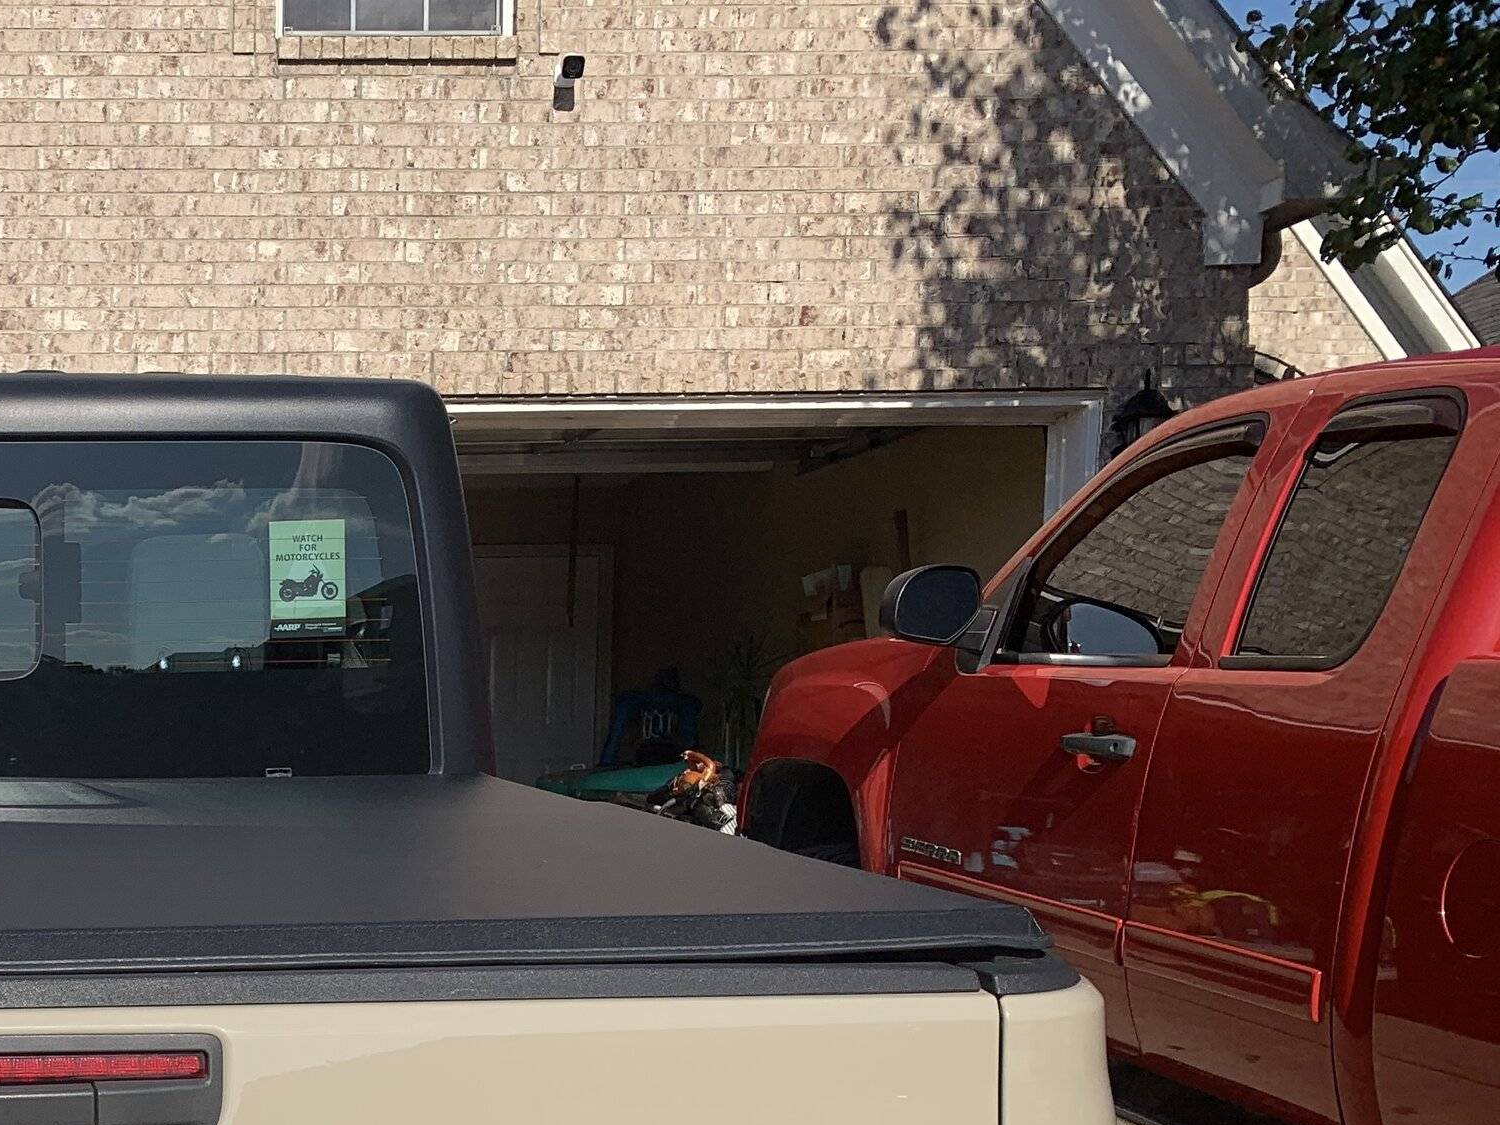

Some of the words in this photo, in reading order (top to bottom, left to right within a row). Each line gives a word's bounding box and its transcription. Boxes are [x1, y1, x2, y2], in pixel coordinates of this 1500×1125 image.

[299, 544, 317, 552] FOR
[276, 552, 340, 561] MOTORCYCLES
[274, 624, 300, 632] AARP
